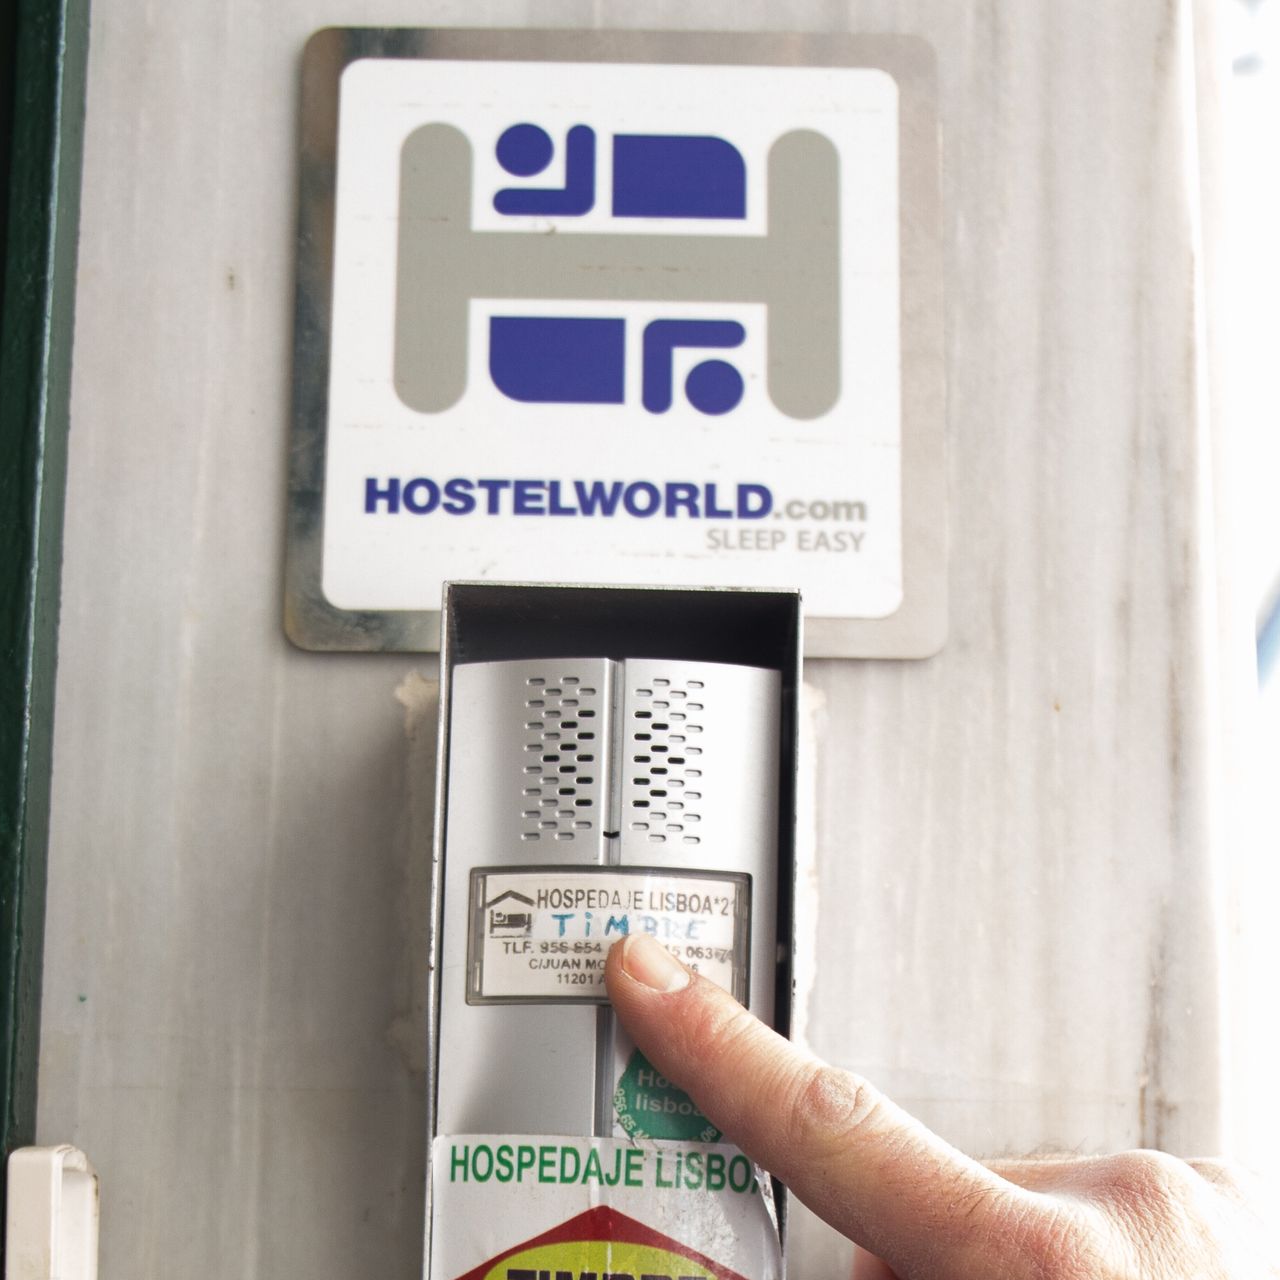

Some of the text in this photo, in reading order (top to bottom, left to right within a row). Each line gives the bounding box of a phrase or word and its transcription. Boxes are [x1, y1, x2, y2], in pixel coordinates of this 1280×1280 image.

[364, 477, 868, 521] HOSTELWORLD.com
[705, 528, 866, 553] SLEEP EASY
[536, 888, 643, 911] HOSPEDAJE
[503, 941, 535, 955] TLF.
[528, 957, 582, 971] C/JUAN
[556, 972, 595, 985] 11201
[448, 1144, 759, 1194] HOSPEDAJE LISBO
